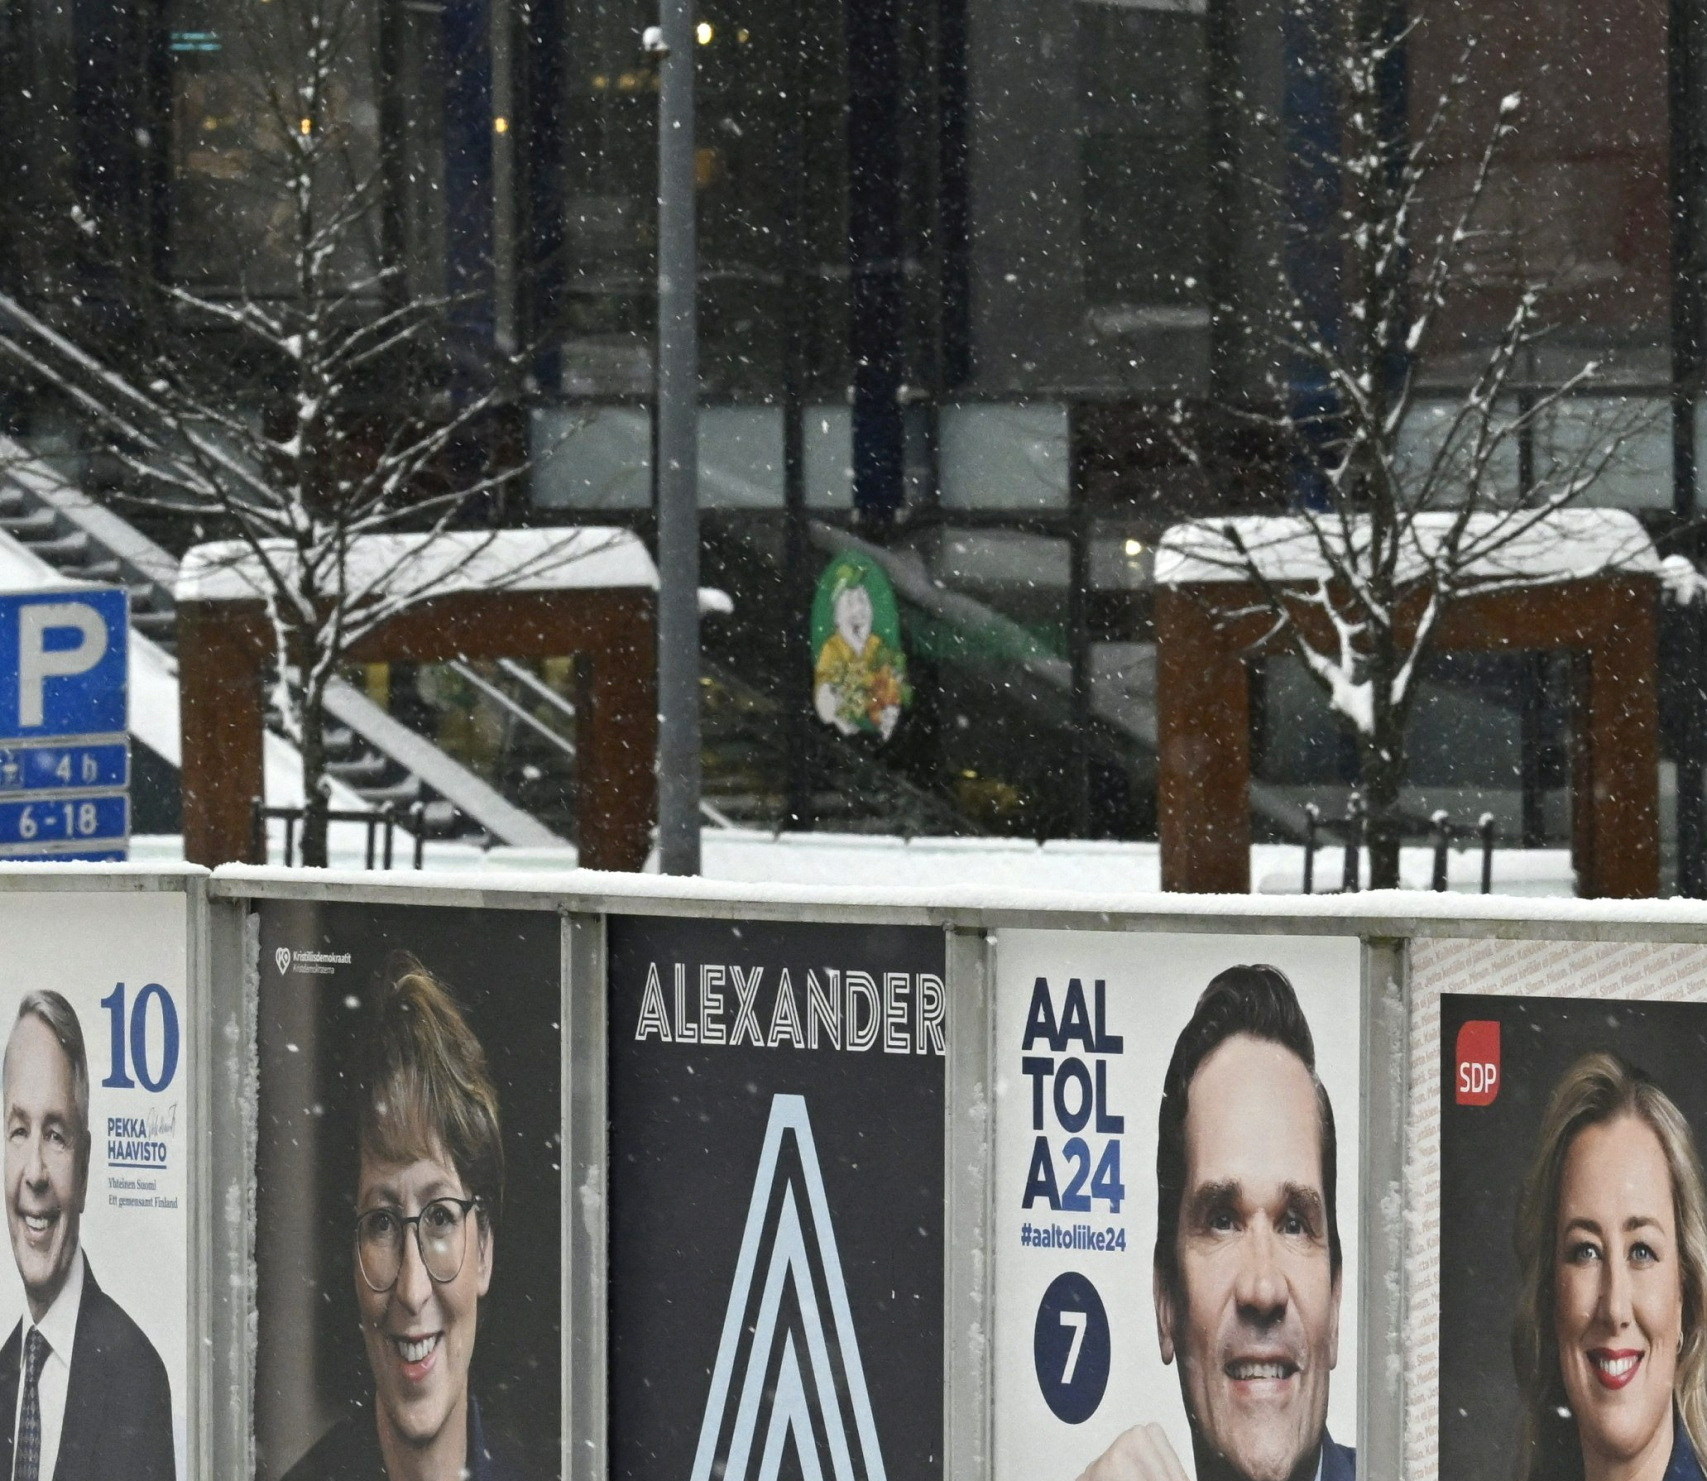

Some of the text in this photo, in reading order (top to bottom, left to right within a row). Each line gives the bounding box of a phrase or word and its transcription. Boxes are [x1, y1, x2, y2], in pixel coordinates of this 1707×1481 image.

[19, 602, 108, 727] P
[55, 753, 71, 781] 4
[101, 982, 179, 1093] 10
[635, 961, 946, 1056] ALEXANDER
[1021, 977, 1124, 1055] AAL
[1021, 1056, 1125, 1135] TOL
[1459, 1062, 1497, 1093] SDP
[107, 1117, 147, 1138] PEKKA
[107, 1140, 167, 1162] HAAVISTO
[1021, 1135, 1126, 1215] A24
[1021, 1222, 1127, 1252] #aaltoliike24
[1059, 1311, 1088, 1385] 7
